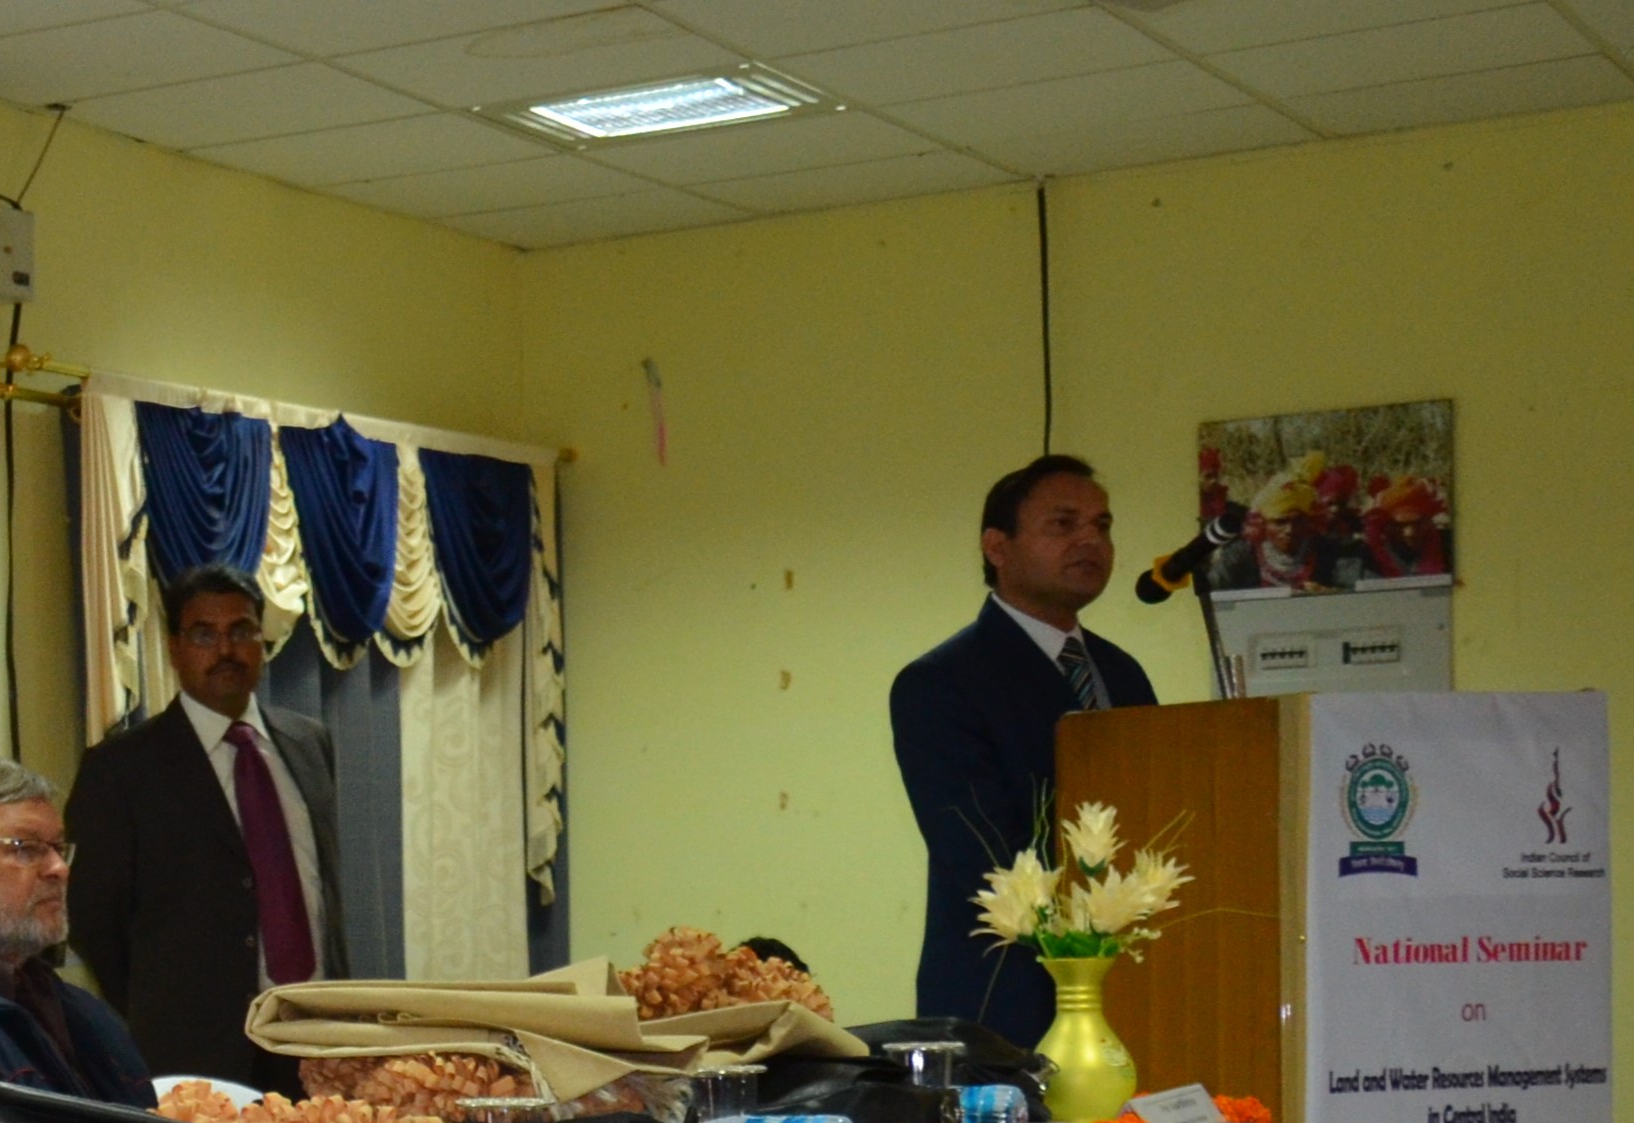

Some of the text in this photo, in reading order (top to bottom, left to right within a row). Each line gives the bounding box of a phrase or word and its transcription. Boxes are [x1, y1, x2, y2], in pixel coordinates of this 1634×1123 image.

[1352, 934, 1589, 966] National Seminar
[1460, 1002, 1487, 1023] on
[1328, 1069, 1360, 1095] Land
[1362, 1068, 1387, 1093] and
[1388, 1067, 1430, 1091] Water
[1487, 1064, 1563, 1091] Management
[1564, 1063, 1608, 1089] Systems
